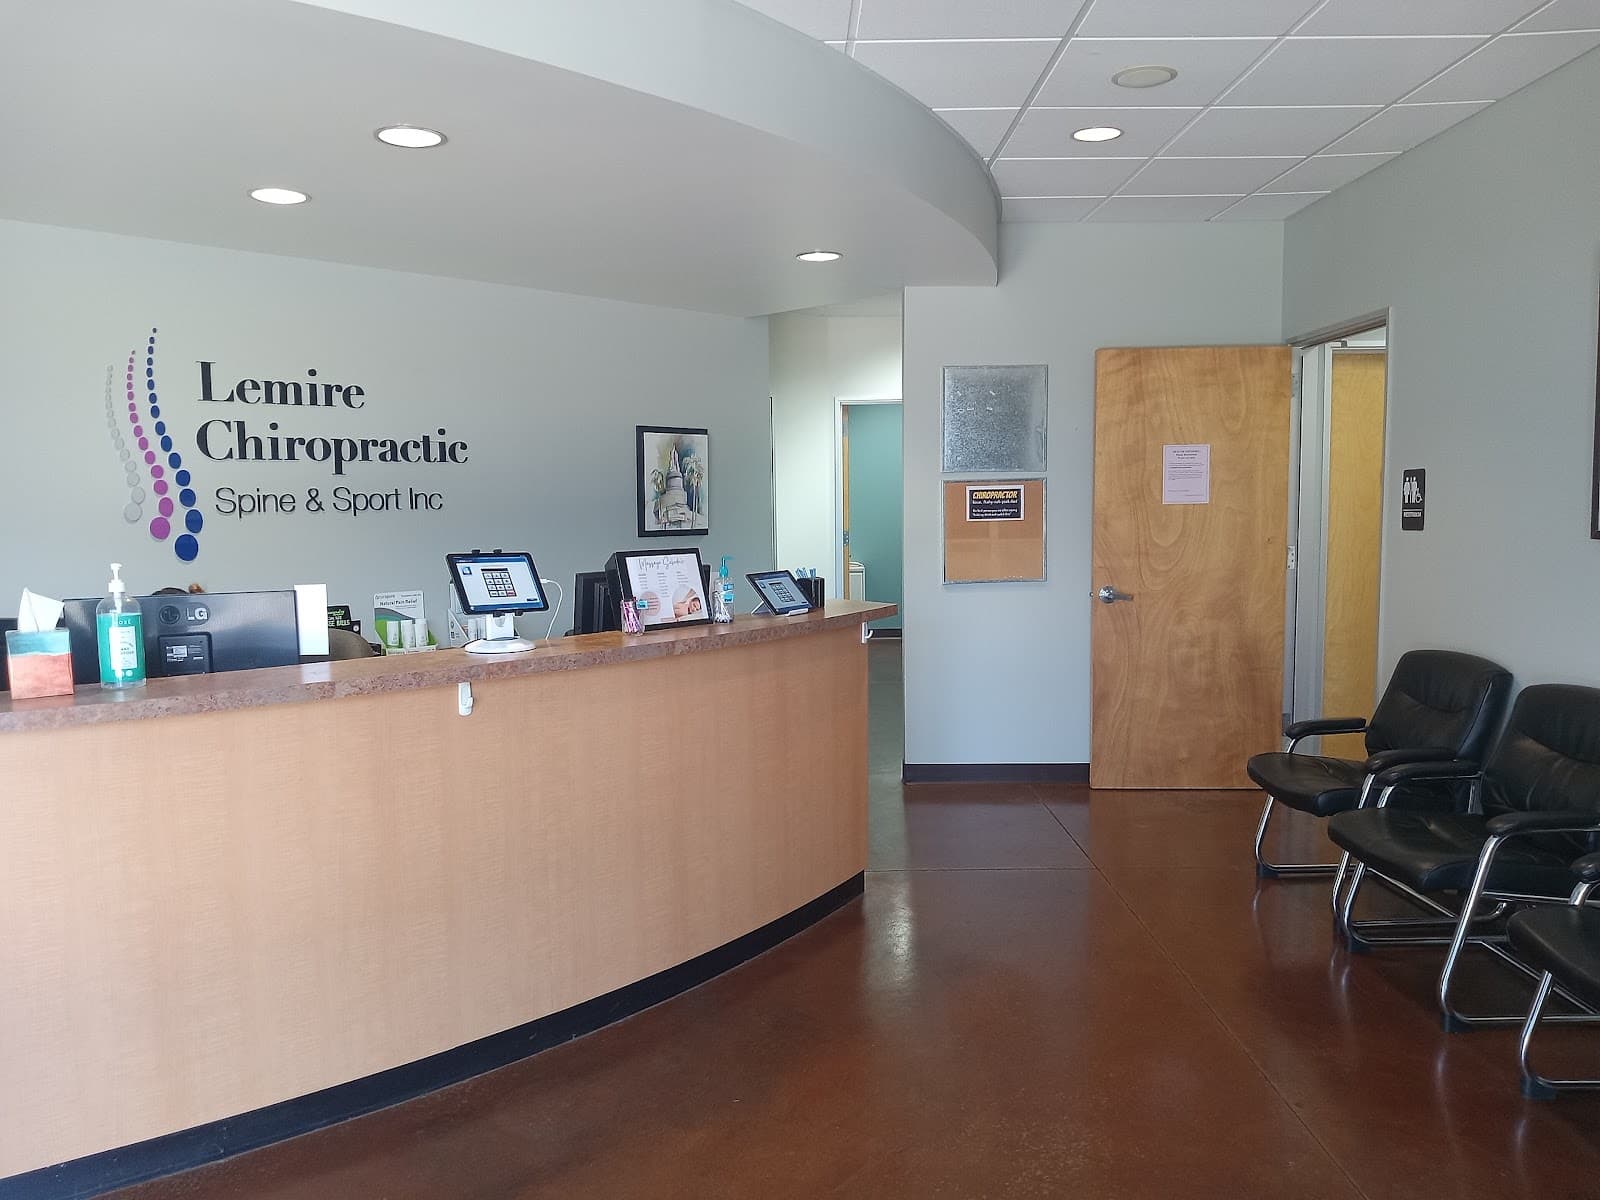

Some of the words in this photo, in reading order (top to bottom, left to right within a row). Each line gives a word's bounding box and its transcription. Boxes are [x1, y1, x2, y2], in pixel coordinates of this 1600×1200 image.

[196, 360, 365, 409] Lemire
[196, 419, 469, 476] Chiropractic
[215, 487, 296, 519] Spine
[305, 488, 325, 512] &
[333, 487, 402, 517] Sport
[409, 487, 443, 511] Inc
[972, 491, 1017, 499] CHIROPRACTOR
[186, 607, 208, 620] LG
